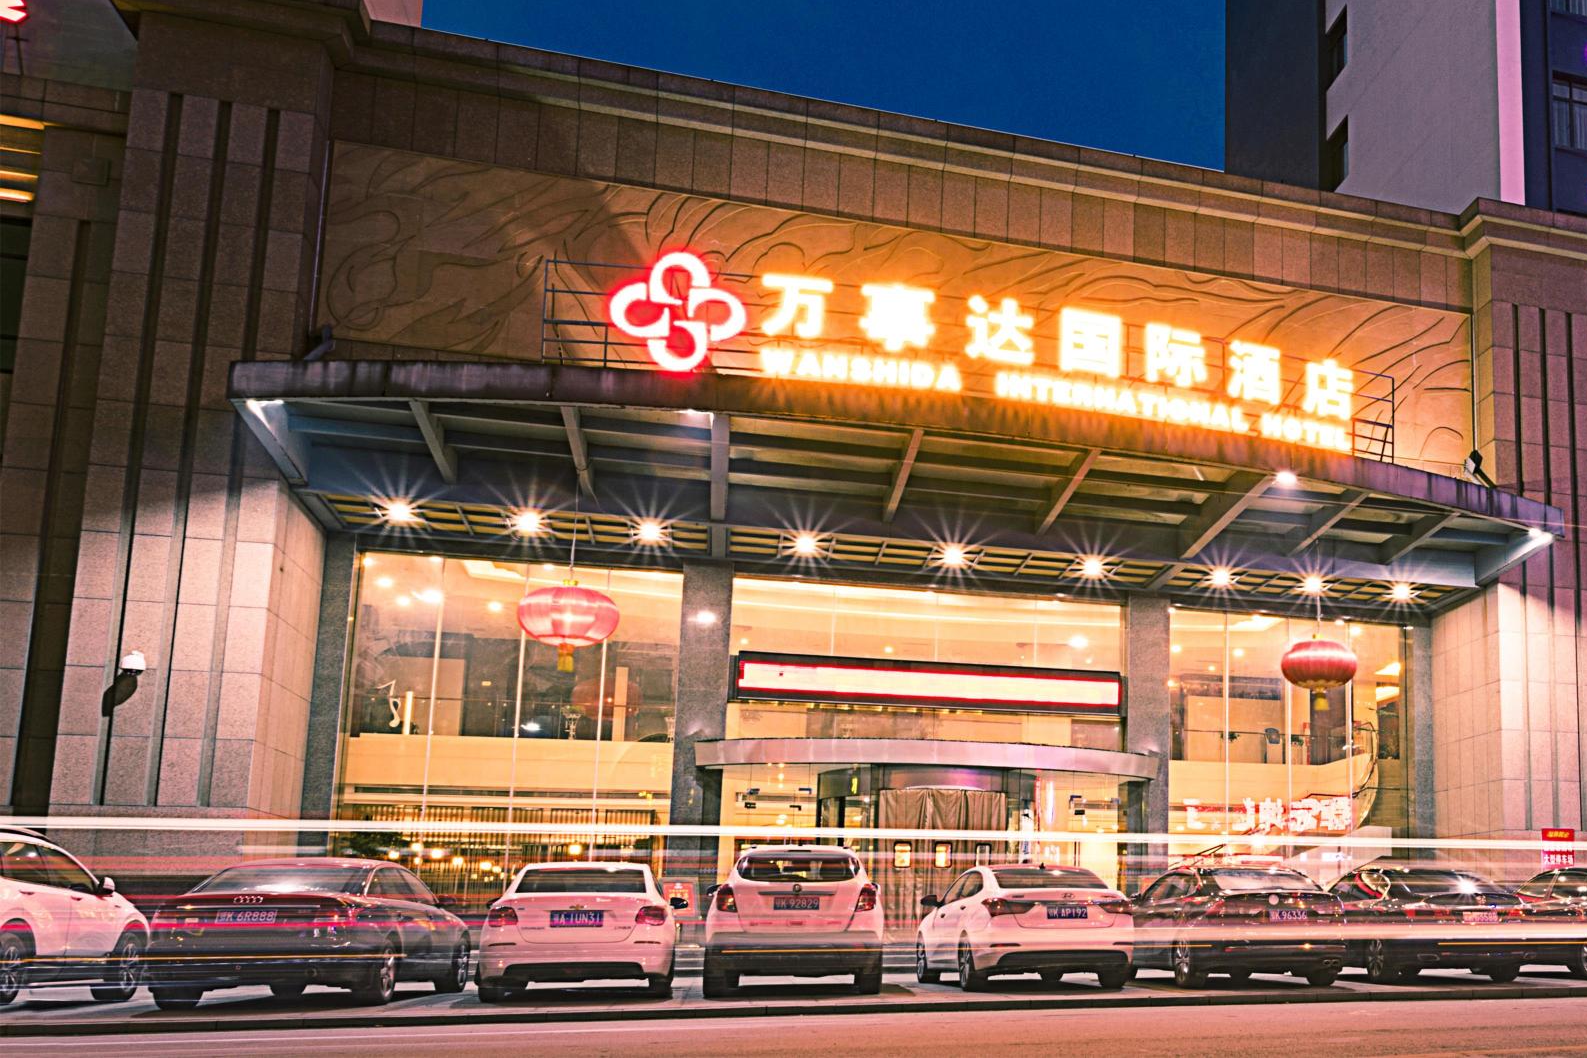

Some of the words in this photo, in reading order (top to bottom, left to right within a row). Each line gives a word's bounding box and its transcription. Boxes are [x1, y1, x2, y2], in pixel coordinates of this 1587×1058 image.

[760, 348, 962, 392] WANSHIDA
[995, 371, 1251, 432] INTERNATIONAL
[1259, 412, 1353, 450] HOTEL
[761, 273, 1354, 419] 万事达国际酒店
